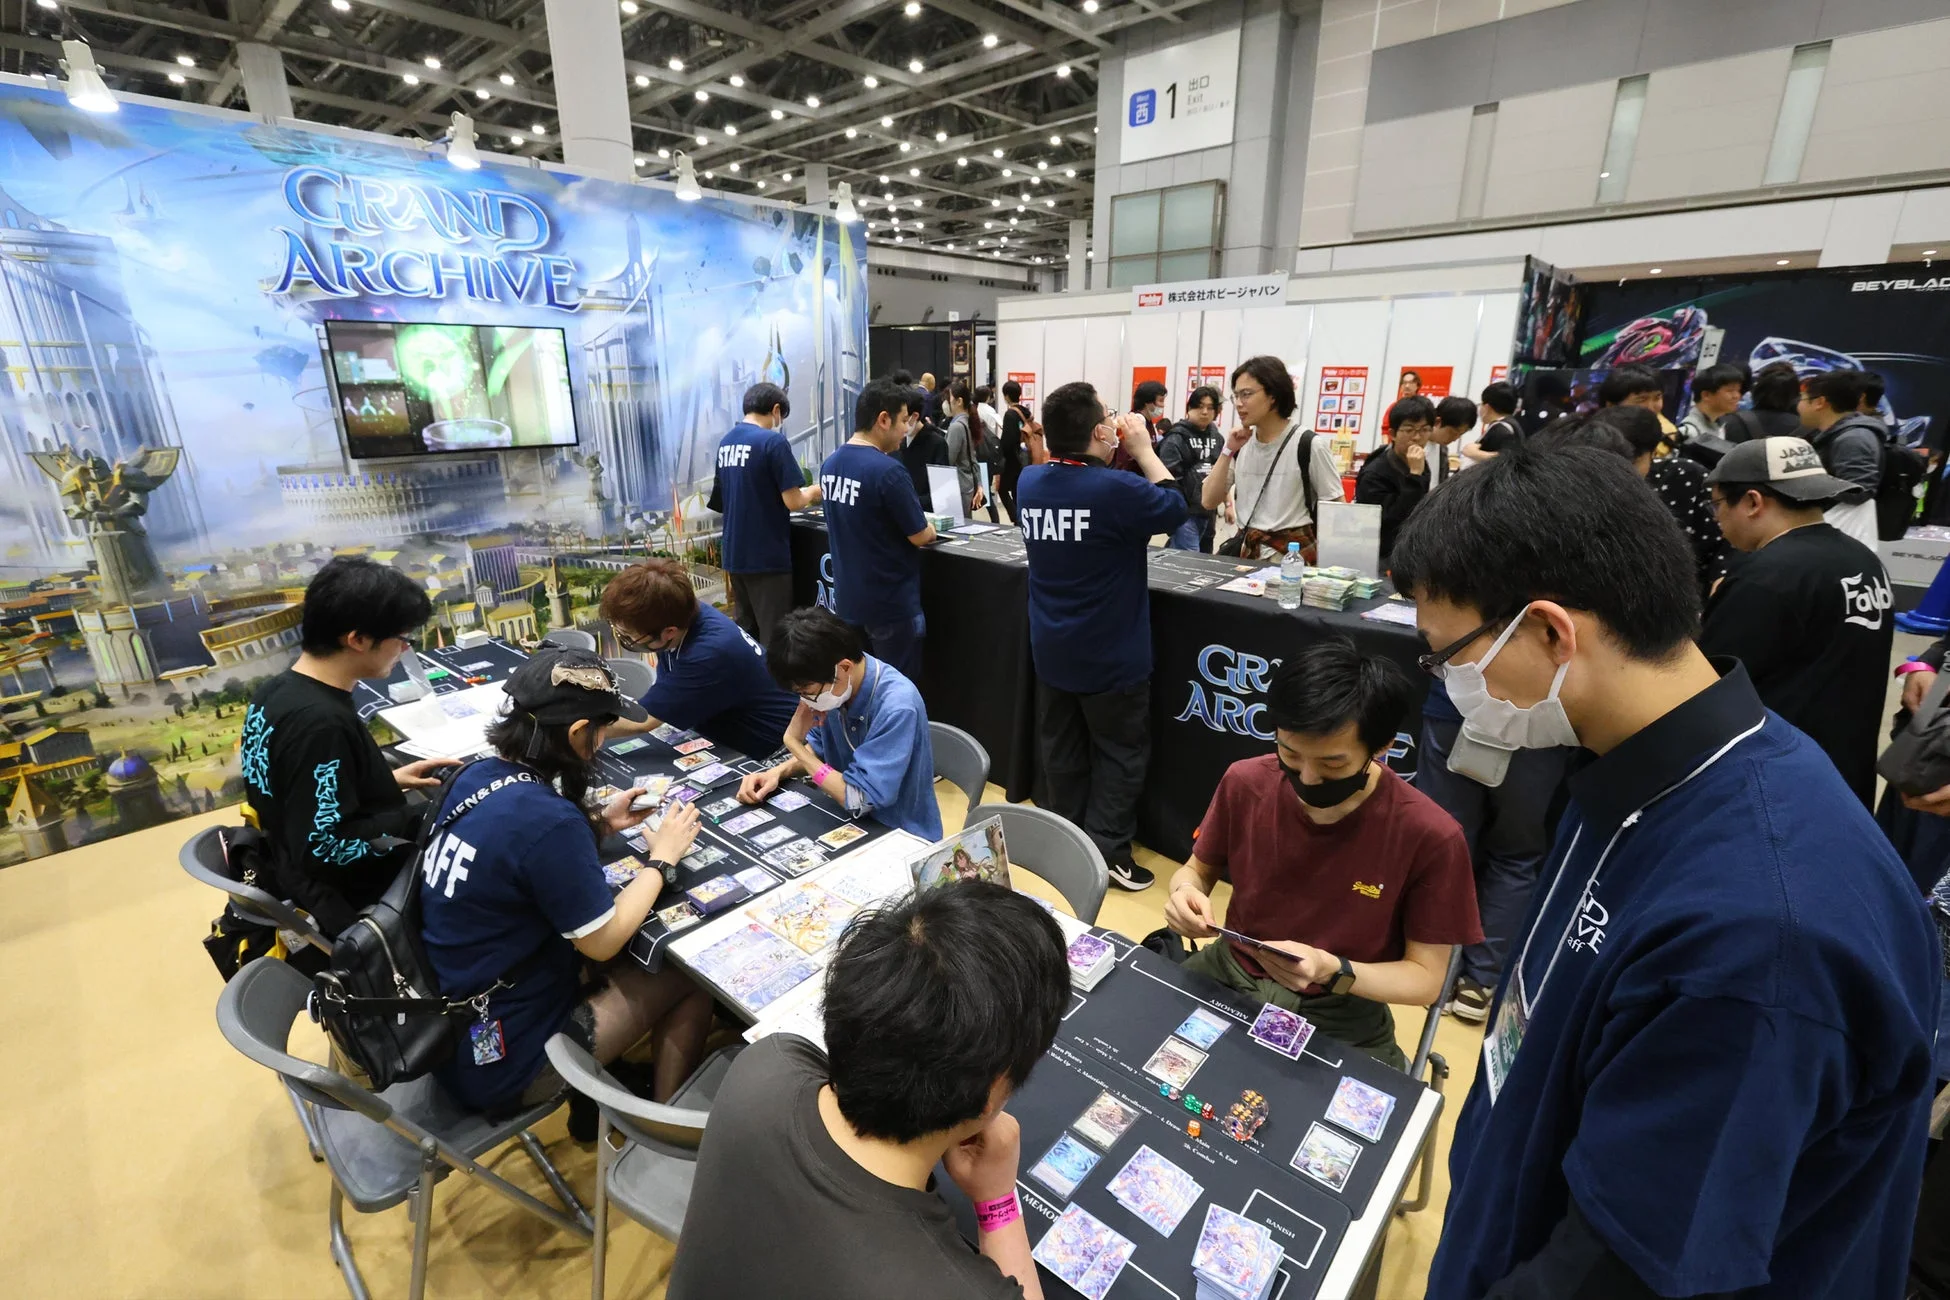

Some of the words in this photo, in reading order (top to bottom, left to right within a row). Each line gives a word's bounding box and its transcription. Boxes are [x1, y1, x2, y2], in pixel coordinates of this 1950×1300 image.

[1188, 75, 1210, 91] 出口
[1166, 82, 1177, 119] 1
[281, 164, 551, 257] GRAND
[262, 225, 585, 313] ARCHIVE
[1167, 286, 1281, 303] 株式会社ホビージャパン
[718, 444, 752, 469] STAFF
[820, 474, 861, 506] STAFF
[1021, 508, 1091, 541] STAFF
[1209, 999, 1249, 1020] MEMORY
[1265, 1218, 1296, 1239] BANISH
